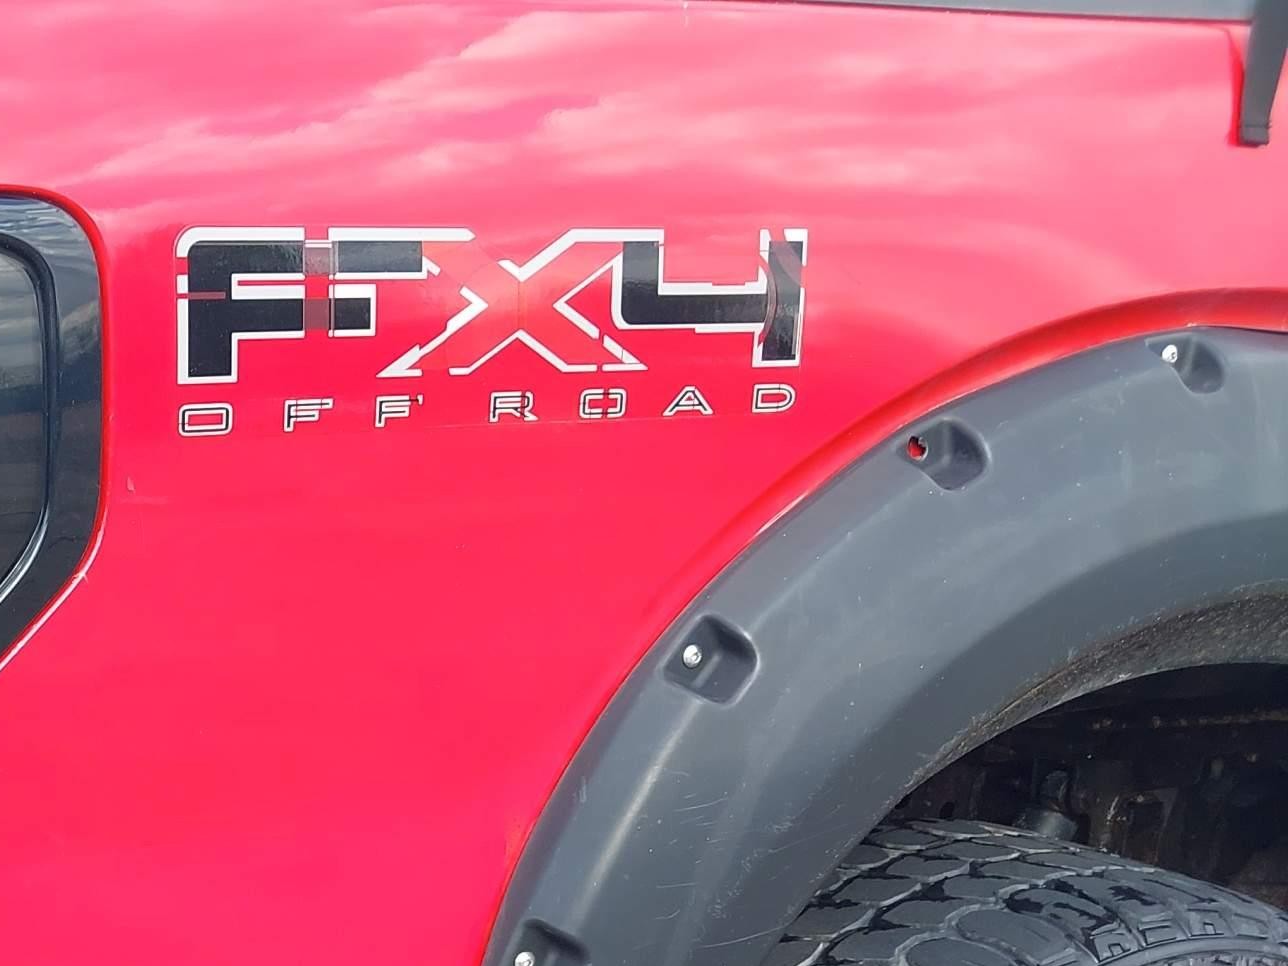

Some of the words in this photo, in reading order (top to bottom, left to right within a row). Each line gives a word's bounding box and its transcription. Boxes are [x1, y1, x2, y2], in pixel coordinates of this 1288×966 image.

[175, 226, 808, 385] FX4
[178, 393, 424, 437] OFF
[487, 383, 797, 422] ROAD
